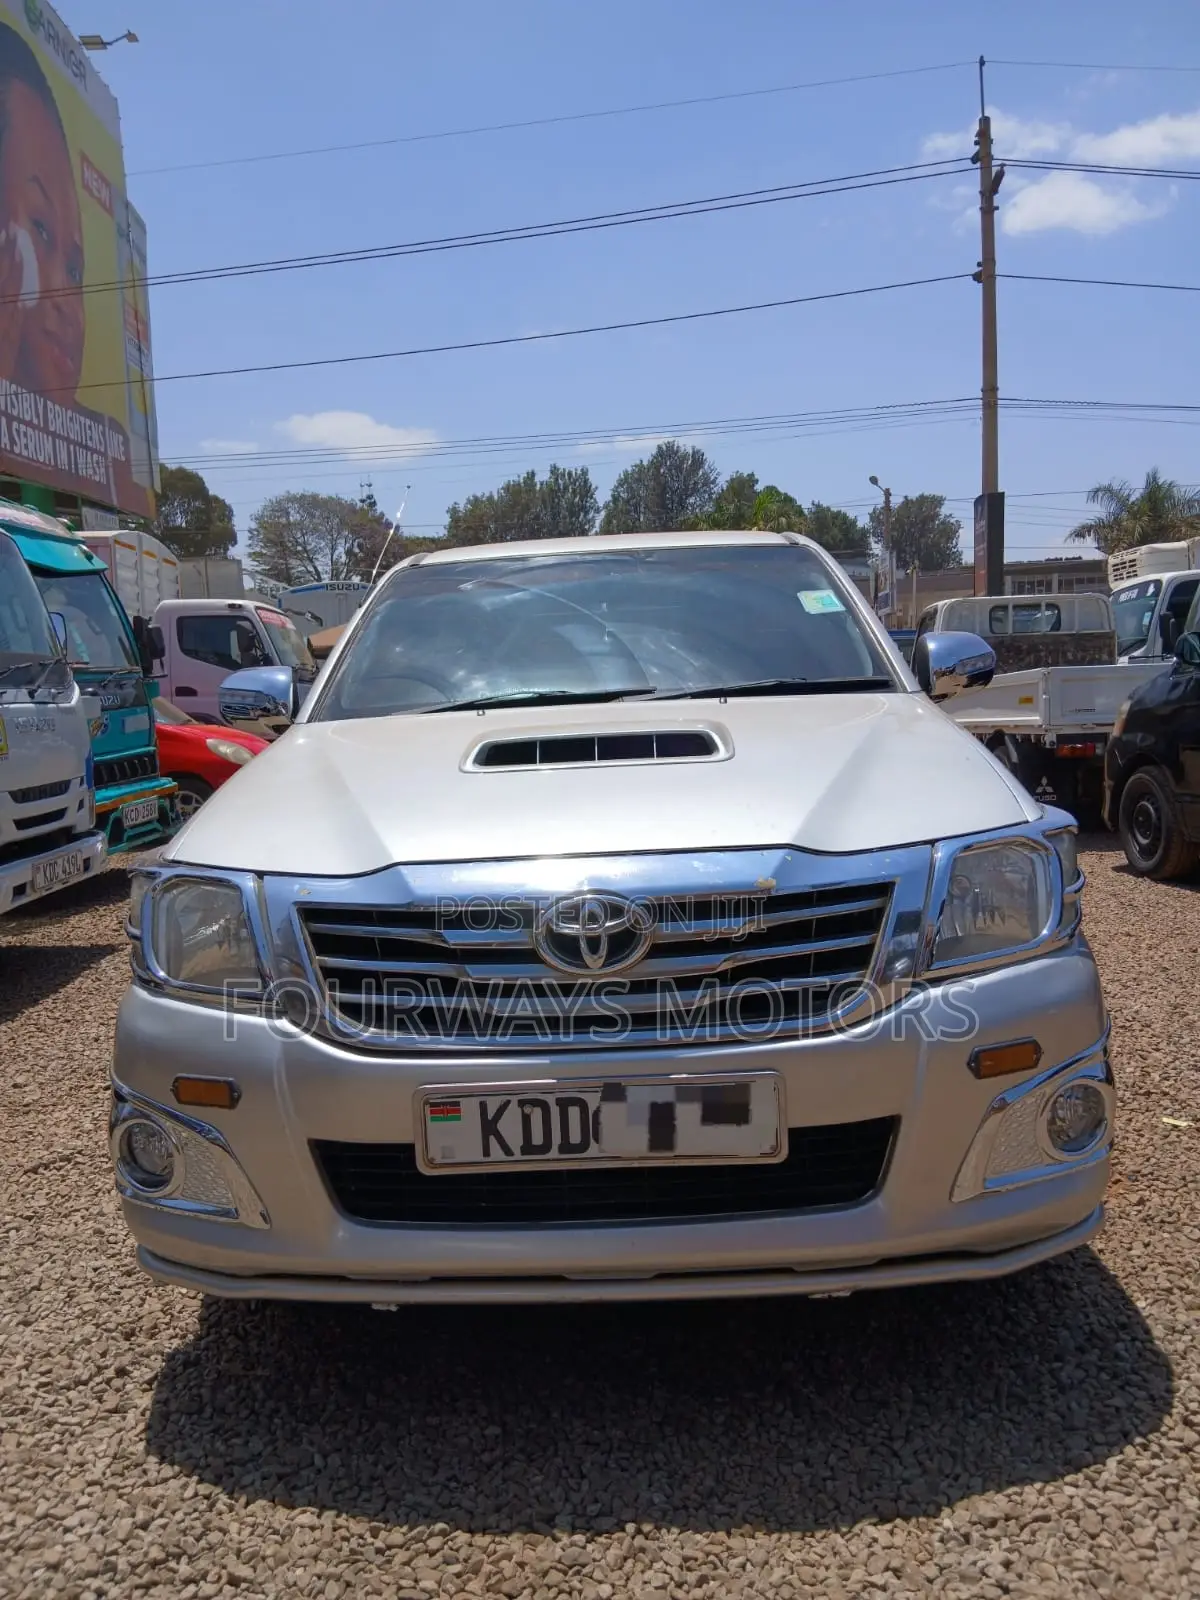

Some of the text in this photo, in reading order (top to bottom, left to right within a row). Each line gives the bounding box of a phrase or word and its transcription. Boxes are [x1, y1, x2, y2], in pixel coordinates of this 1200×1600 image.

[0, 377, 126, 462] VISIBLY BRIGHTENS LIKE
[0, 416, 11, 449] A
[12, 422, 55, 466] SERUM
[55, 438, 69, 470] IN
[76, 448, 107, 485] WASH
[325, 583, 360, 592] ISUZU
[124, 807, 140, 826] KCD
